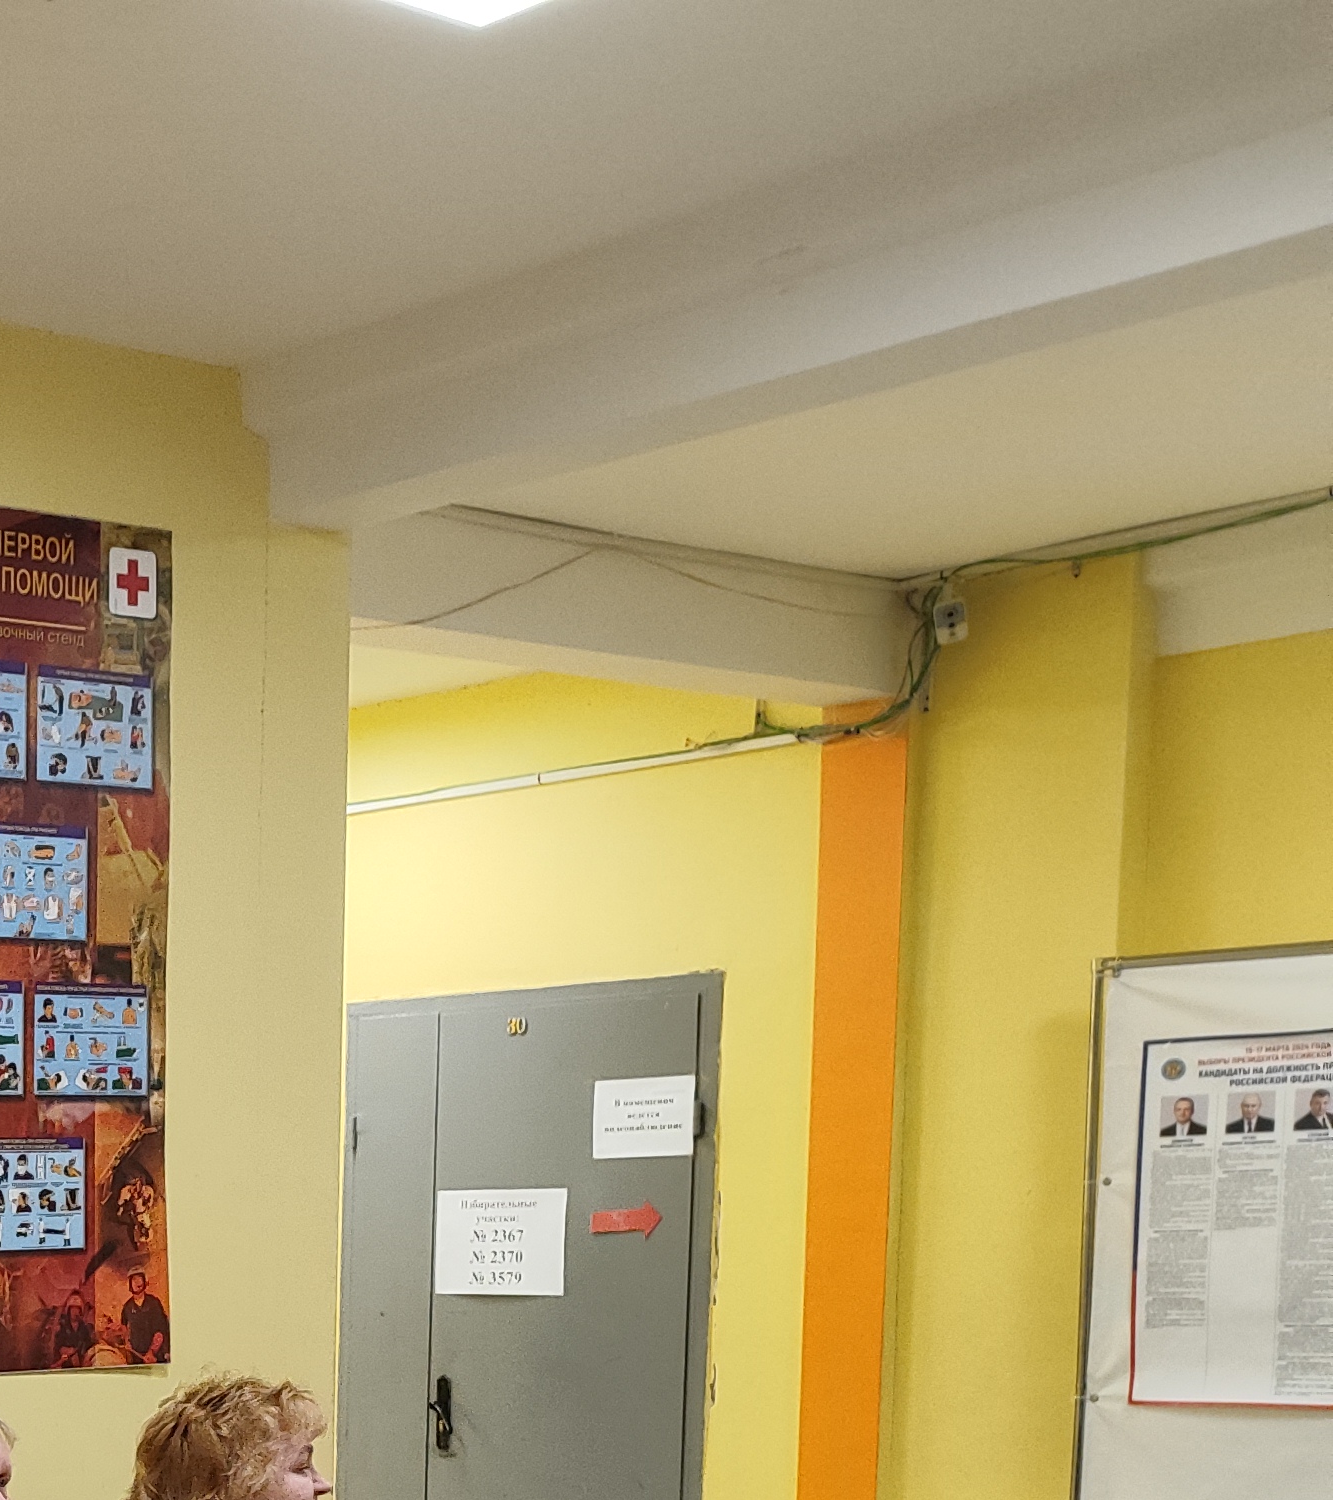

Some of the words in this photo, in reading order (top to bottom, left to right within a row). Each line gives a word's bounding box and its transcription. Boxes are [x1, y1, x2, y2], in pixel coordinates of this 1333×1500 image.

[0, 567, 100, 606] ПОМОЩИ
[46, 629, 86, 648] стенд
[1198, 1066, 1251, 1078] КАНДИДАТЫ
[1252, 1065, 1264, 1075] НА
[1266, 1062, 1321, 1075] ДОЛЖНОСТЬ
[1289, 1072, 1333, 1084] ФЕДЕРАЦ
[469, 1229, 487, 1243] №
[491, 1229, 524, 1243] 2367
[469, 1250, 486, 1264] №
[490, 1250, 523, 1264] 2370
[468, 1271, 485, 1285] №
[488, 1271, 522, 1285] 3579
